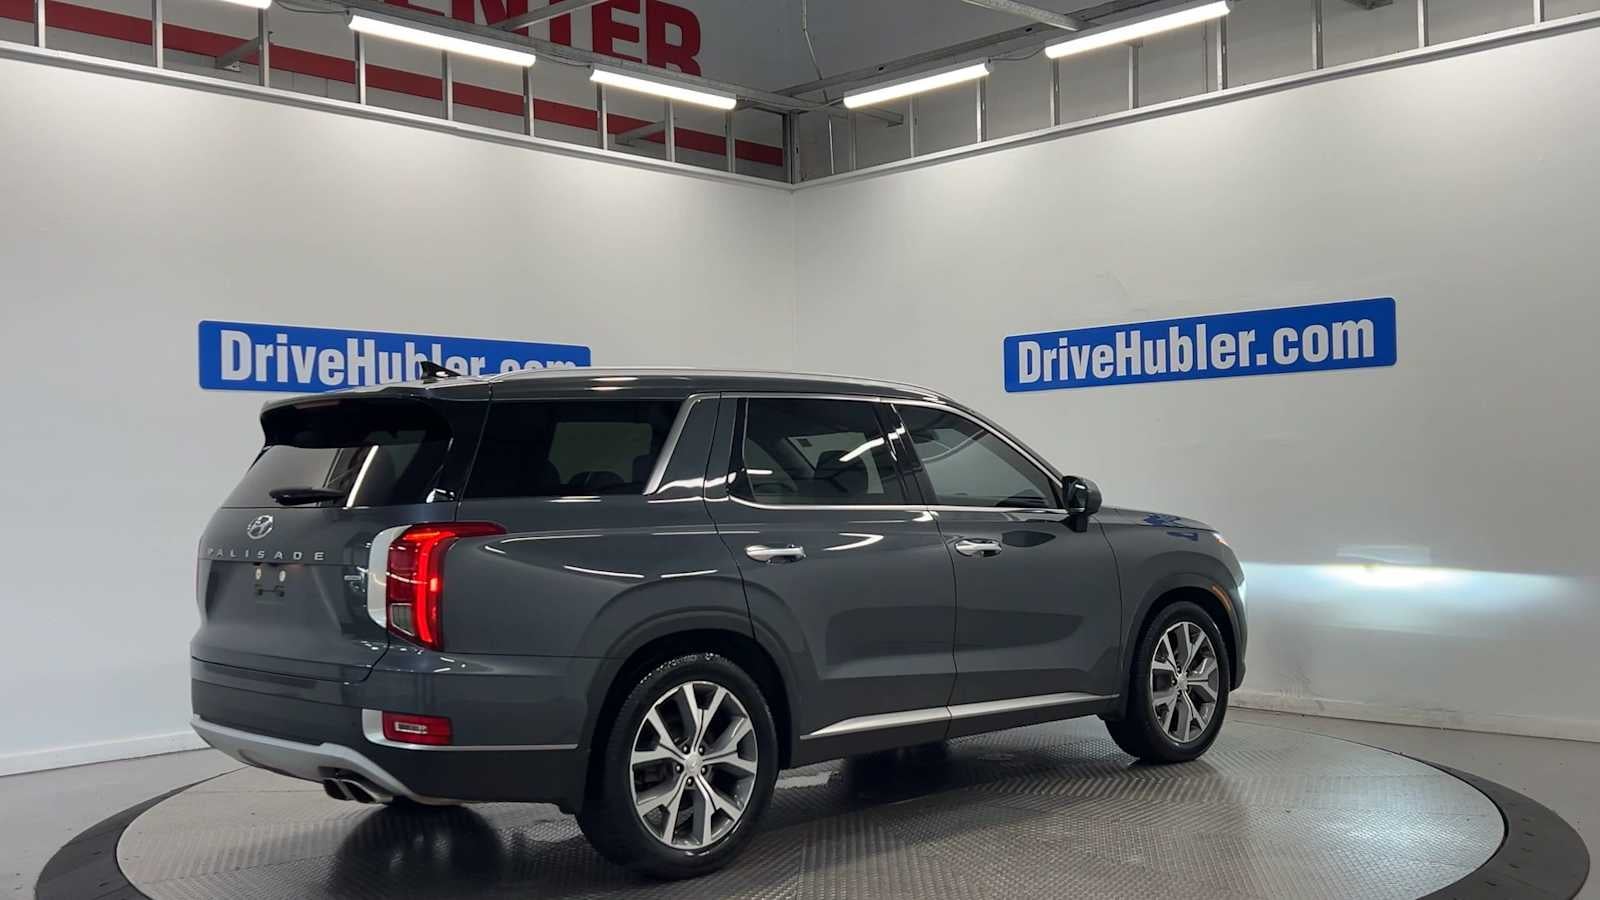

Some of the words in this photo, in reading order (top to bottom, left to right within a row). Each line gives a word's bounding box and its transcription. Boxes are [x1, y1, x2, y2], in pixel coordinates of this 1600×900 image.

[220, 329, 577, 386] DriveHubler
[1018, 318, 1375, 384] DriveHubler.com
[207, 548, 325, 562] PALISADE
